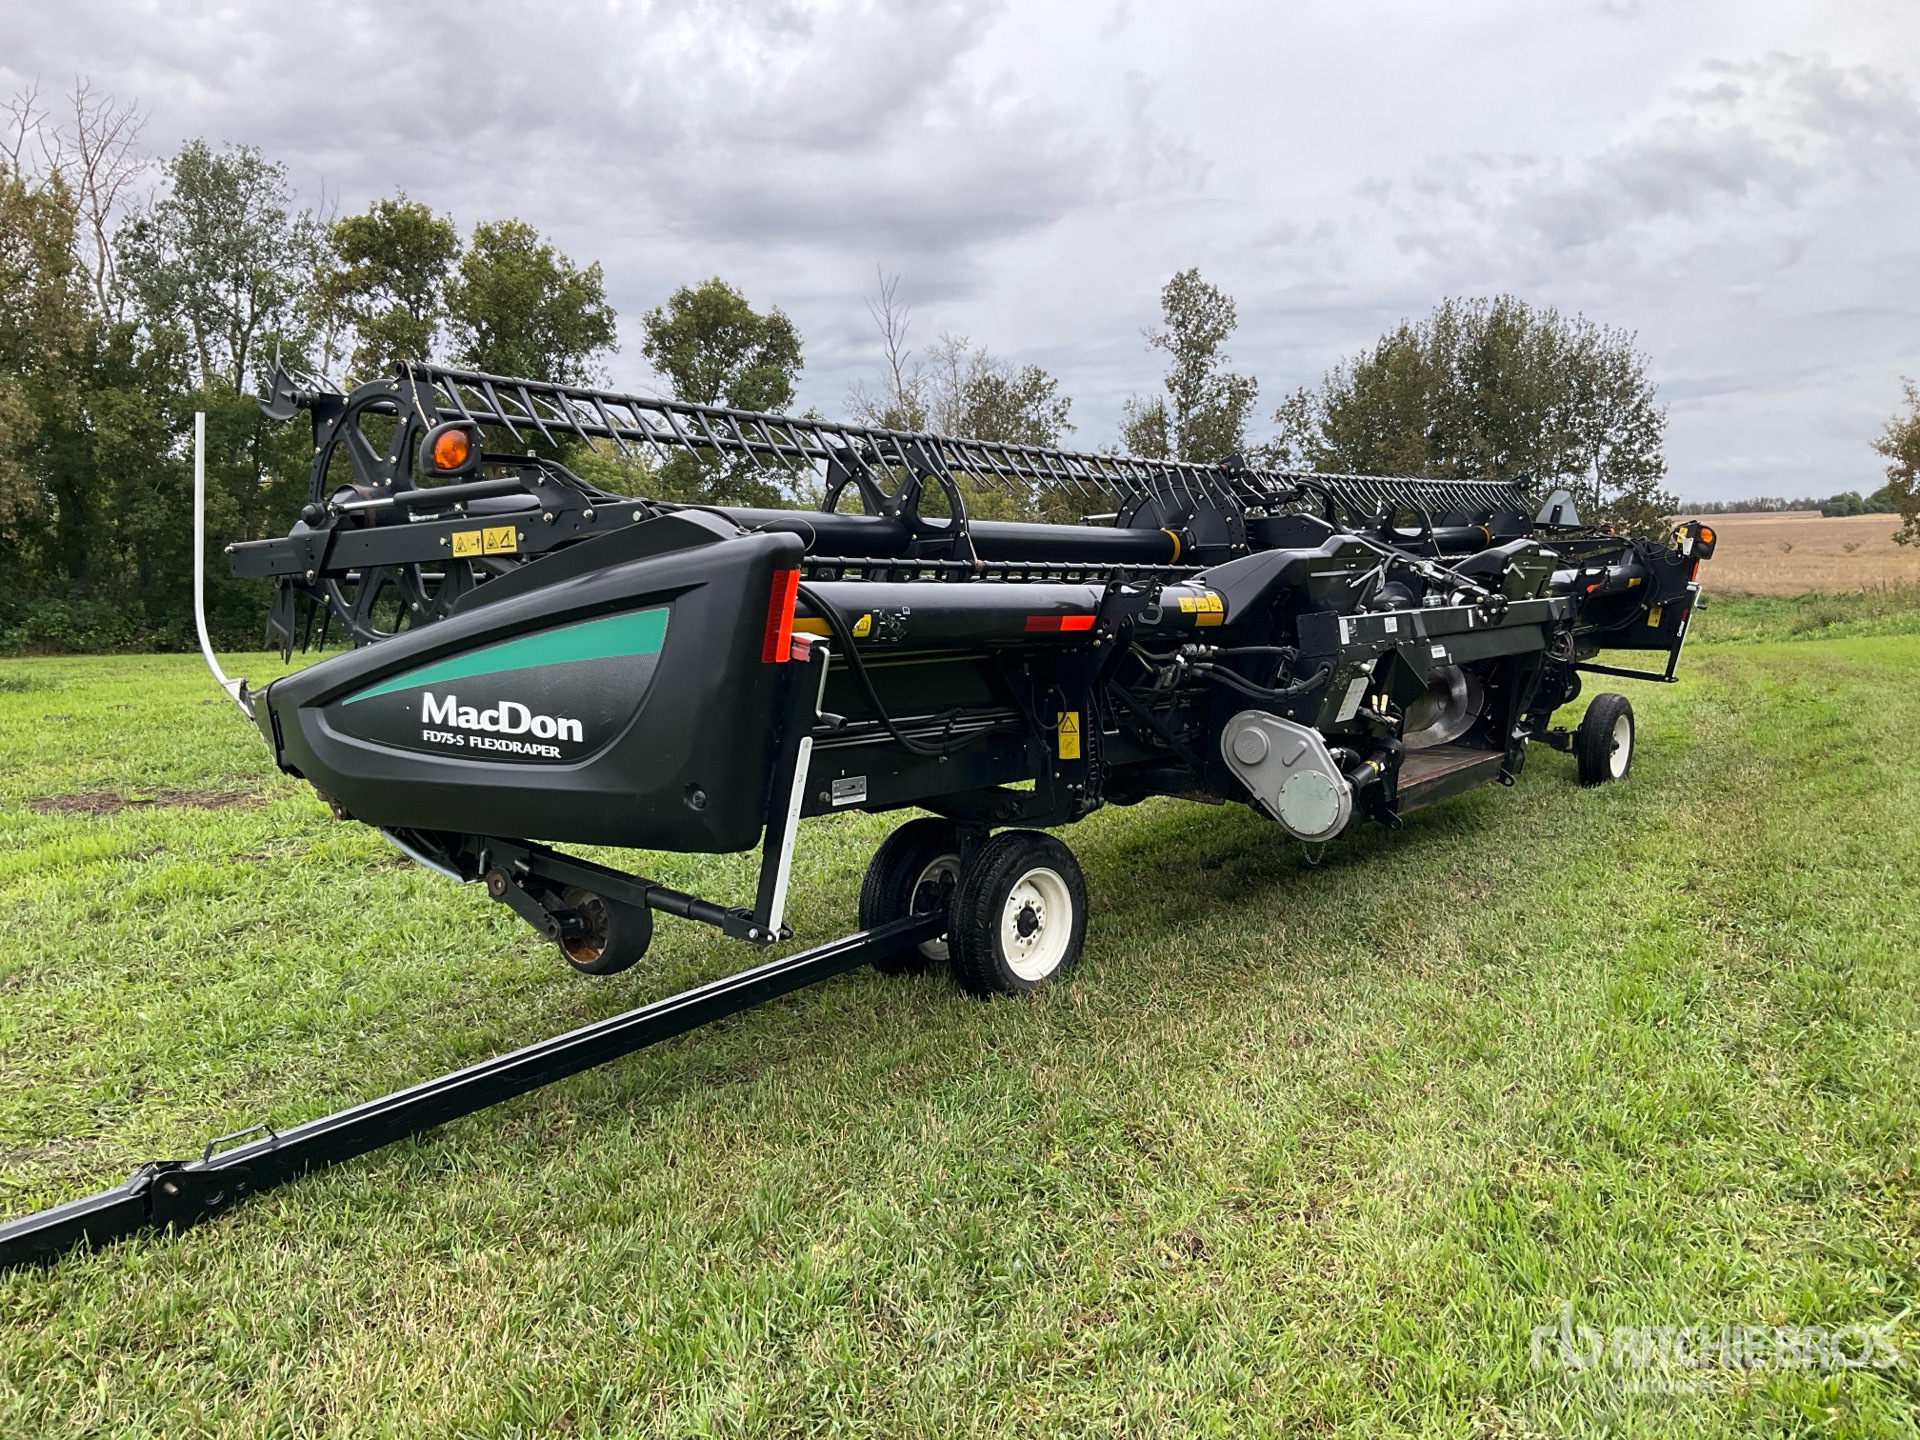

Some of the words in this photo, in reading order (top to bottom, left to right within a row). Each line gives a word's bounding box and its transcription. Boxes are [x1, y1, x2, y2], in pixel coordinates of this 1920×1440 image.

[422, 692, 584, 742] MacDon
[423, 730, 465, 746] FD75-S
[469, 736, 562, 758] FLEXDRAPER
